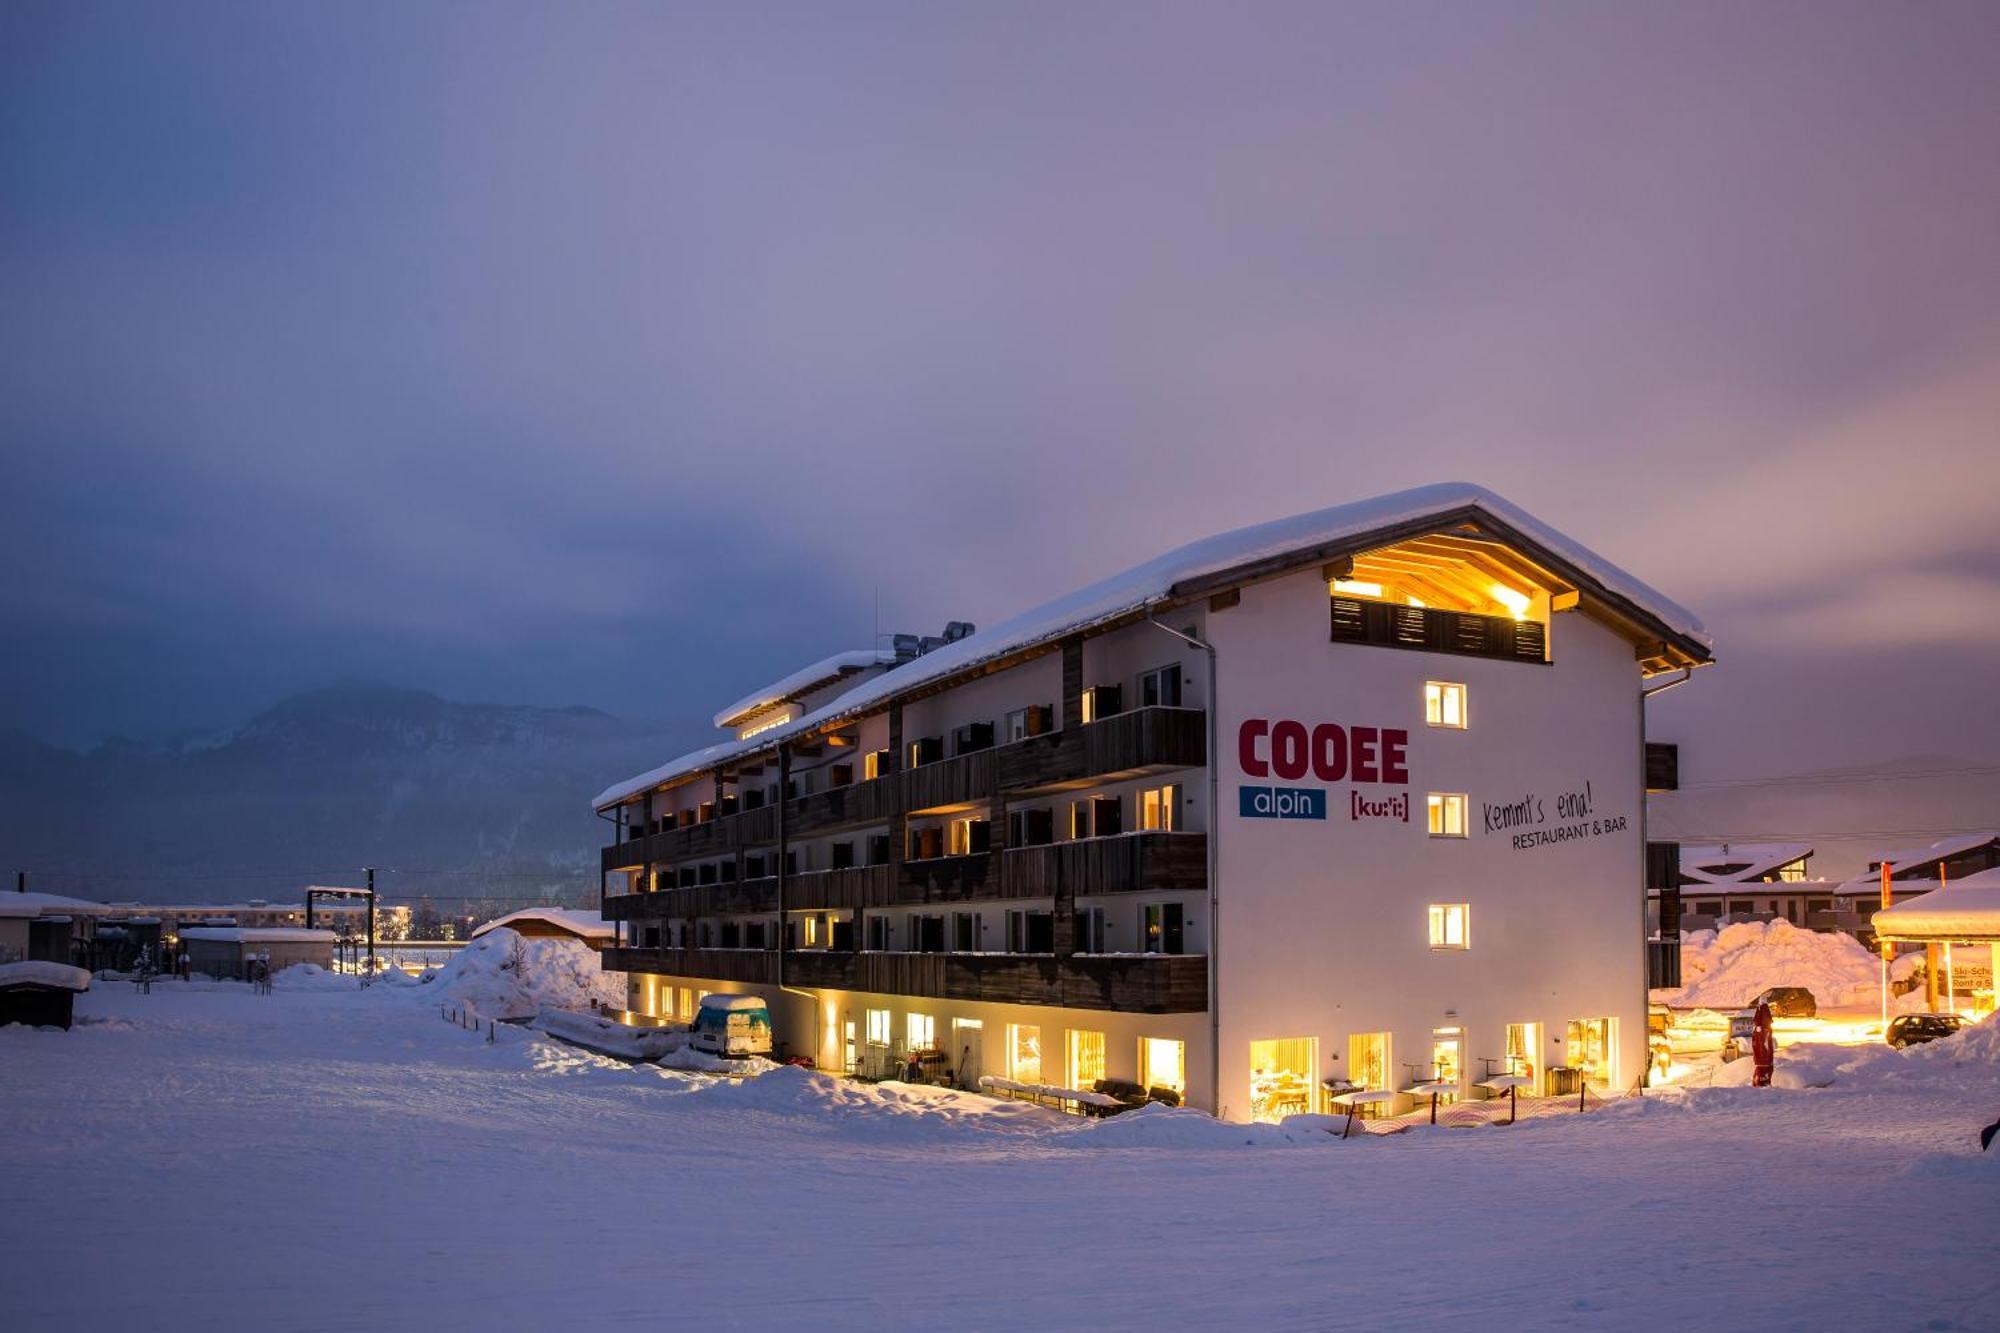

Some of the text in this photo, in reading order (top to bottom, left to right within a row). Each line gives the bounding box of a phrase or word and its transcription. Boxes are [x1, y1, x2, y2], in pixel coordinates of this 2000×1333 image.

[1239, 719, 1408, 784] COOEE
[1254, 789, 1312, 818] alpin
[1512, 816, 1627, 850] RESTAURANT & BAR
